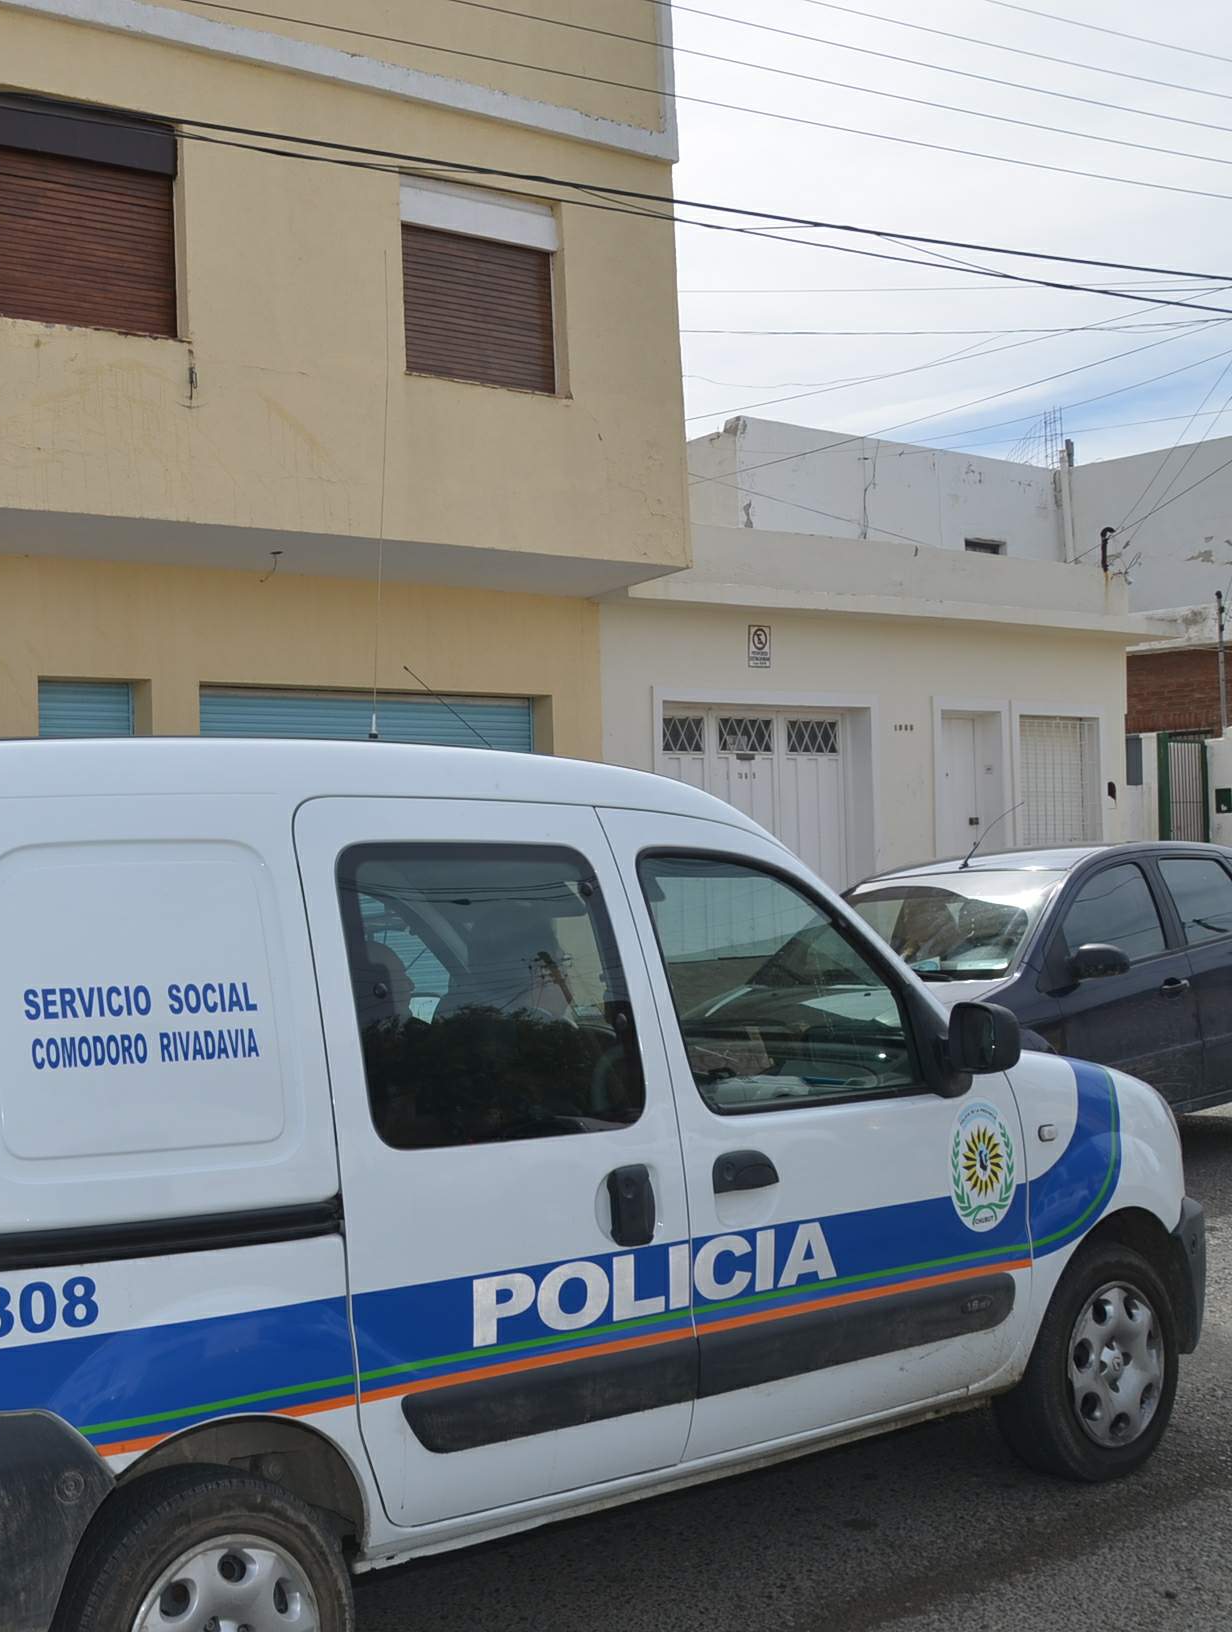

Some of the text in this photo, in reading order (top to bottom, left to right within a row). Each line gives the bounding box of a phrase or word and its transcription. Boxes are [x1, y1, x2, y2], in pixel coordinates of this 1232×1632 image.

[24, 982, 257, 1020] SERVICIO SOCIAL
[32, 1028, 260, 1070] COMODORO RIVADAVIA
[473, 1222, 837, 1348] POLICIA
